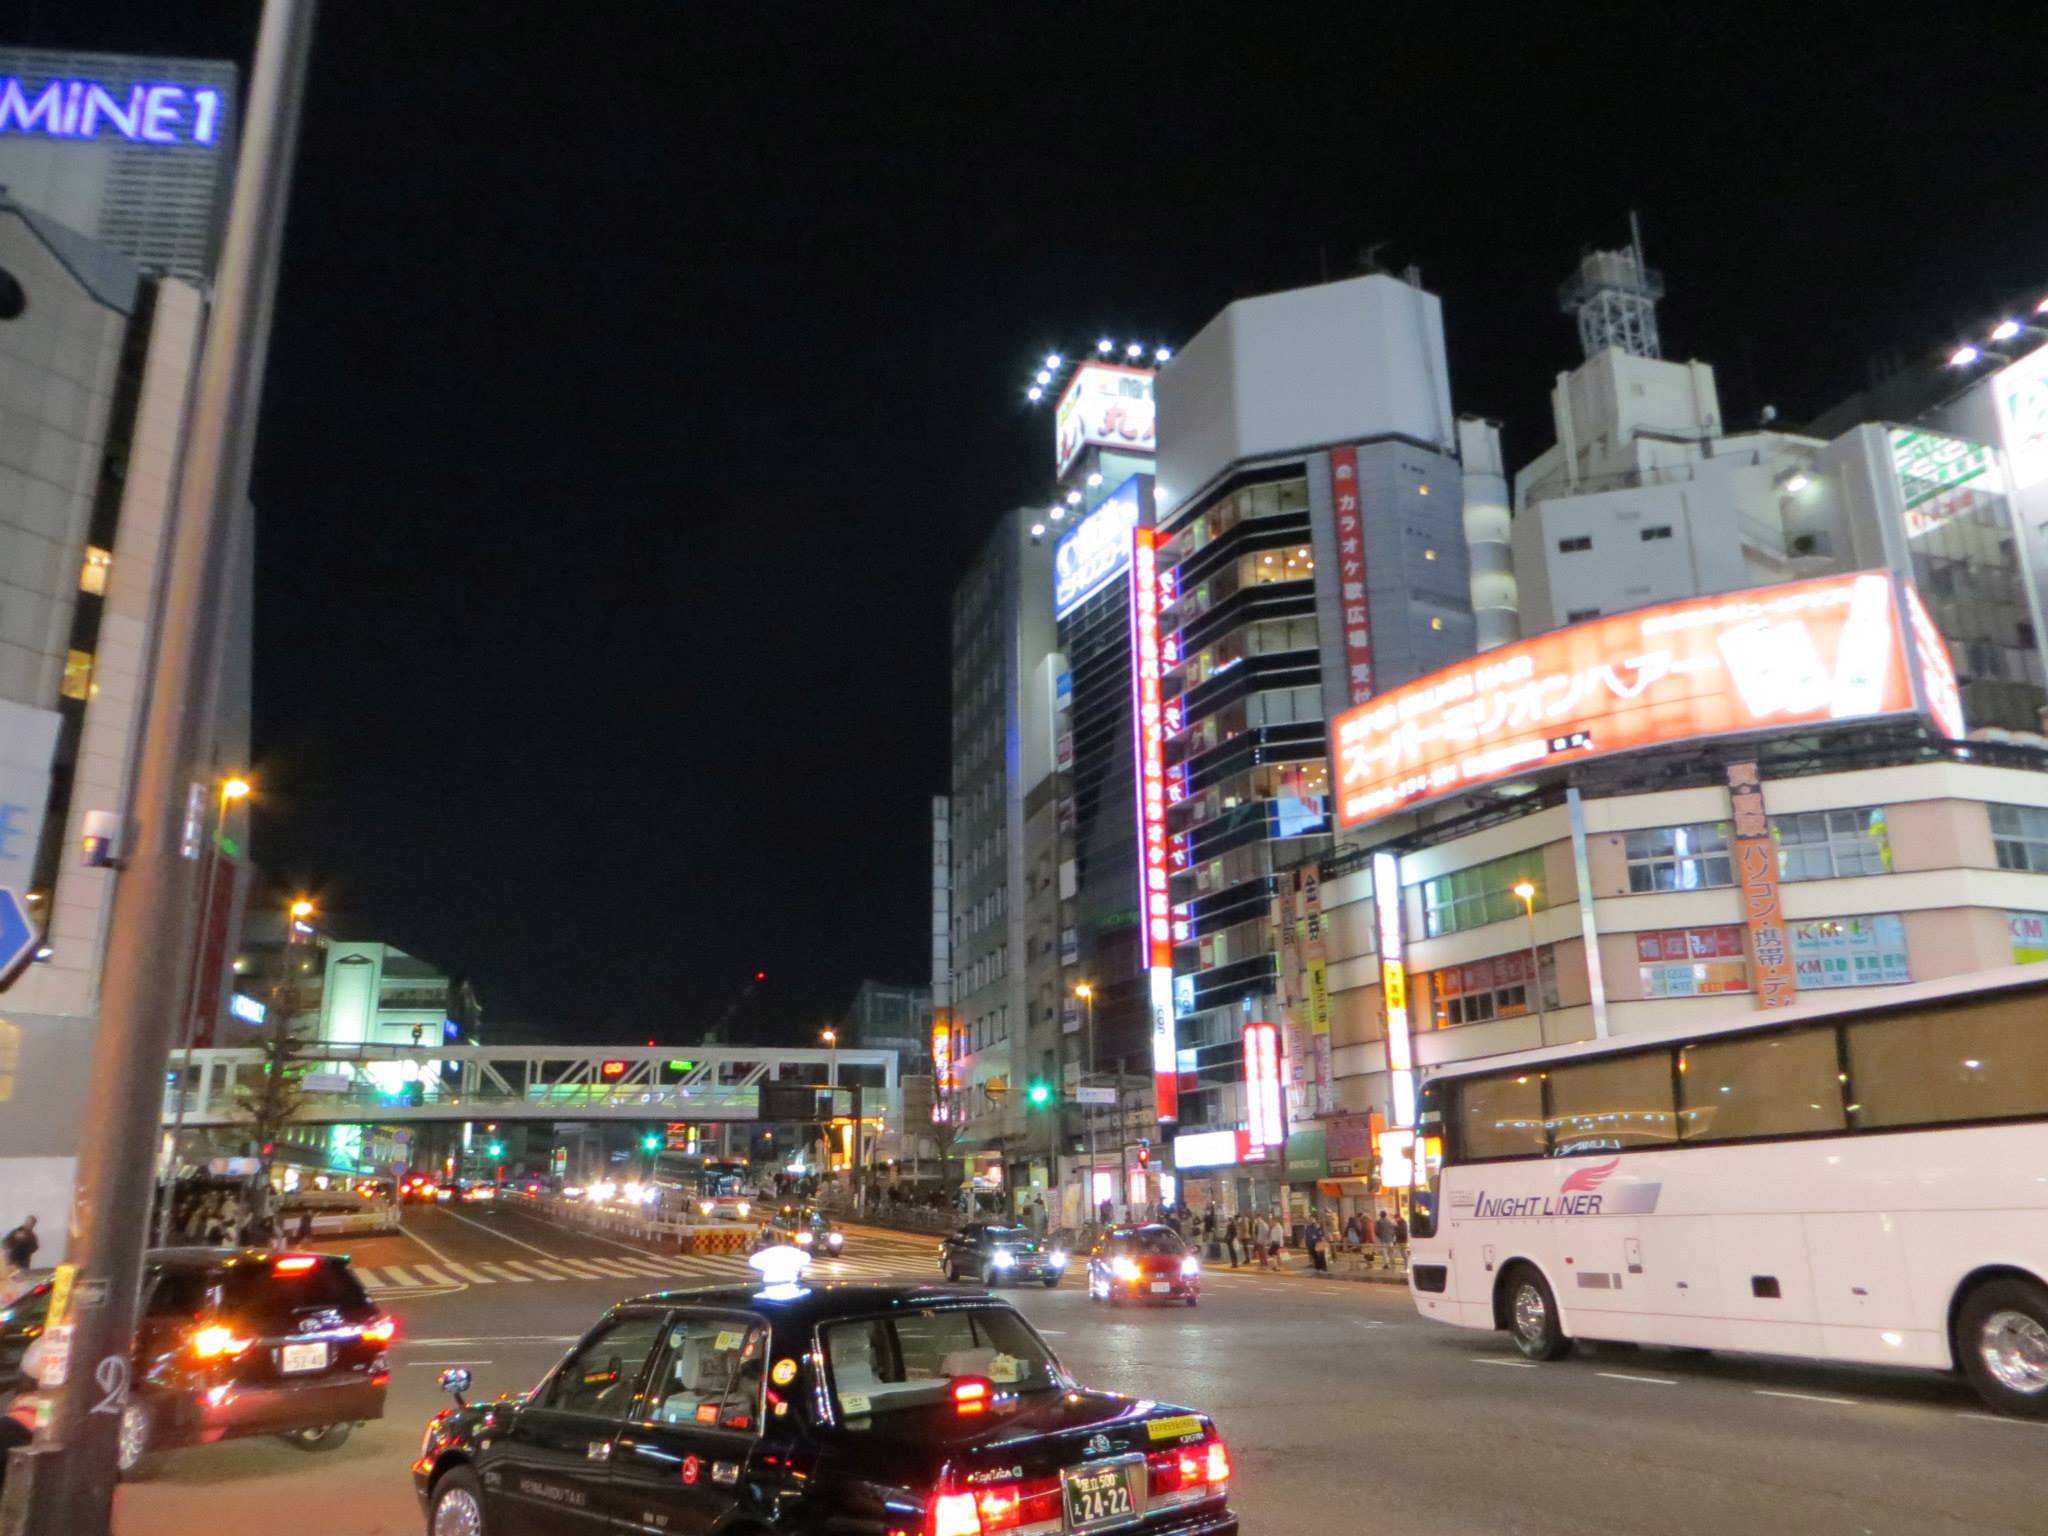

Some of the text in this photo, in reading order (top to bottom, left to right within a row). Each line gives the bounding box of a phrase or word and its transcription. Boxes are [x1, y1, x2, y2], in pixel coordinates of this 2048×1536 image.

[1341, 649, 1720, 785] スーパーミリオンヘアー
[1480, 1195, 1602, 1216] NIGHT LINER
[1081, 1473, 1116, 1492] 足立 500
[564, 1488, 586, 1507] TAXI
